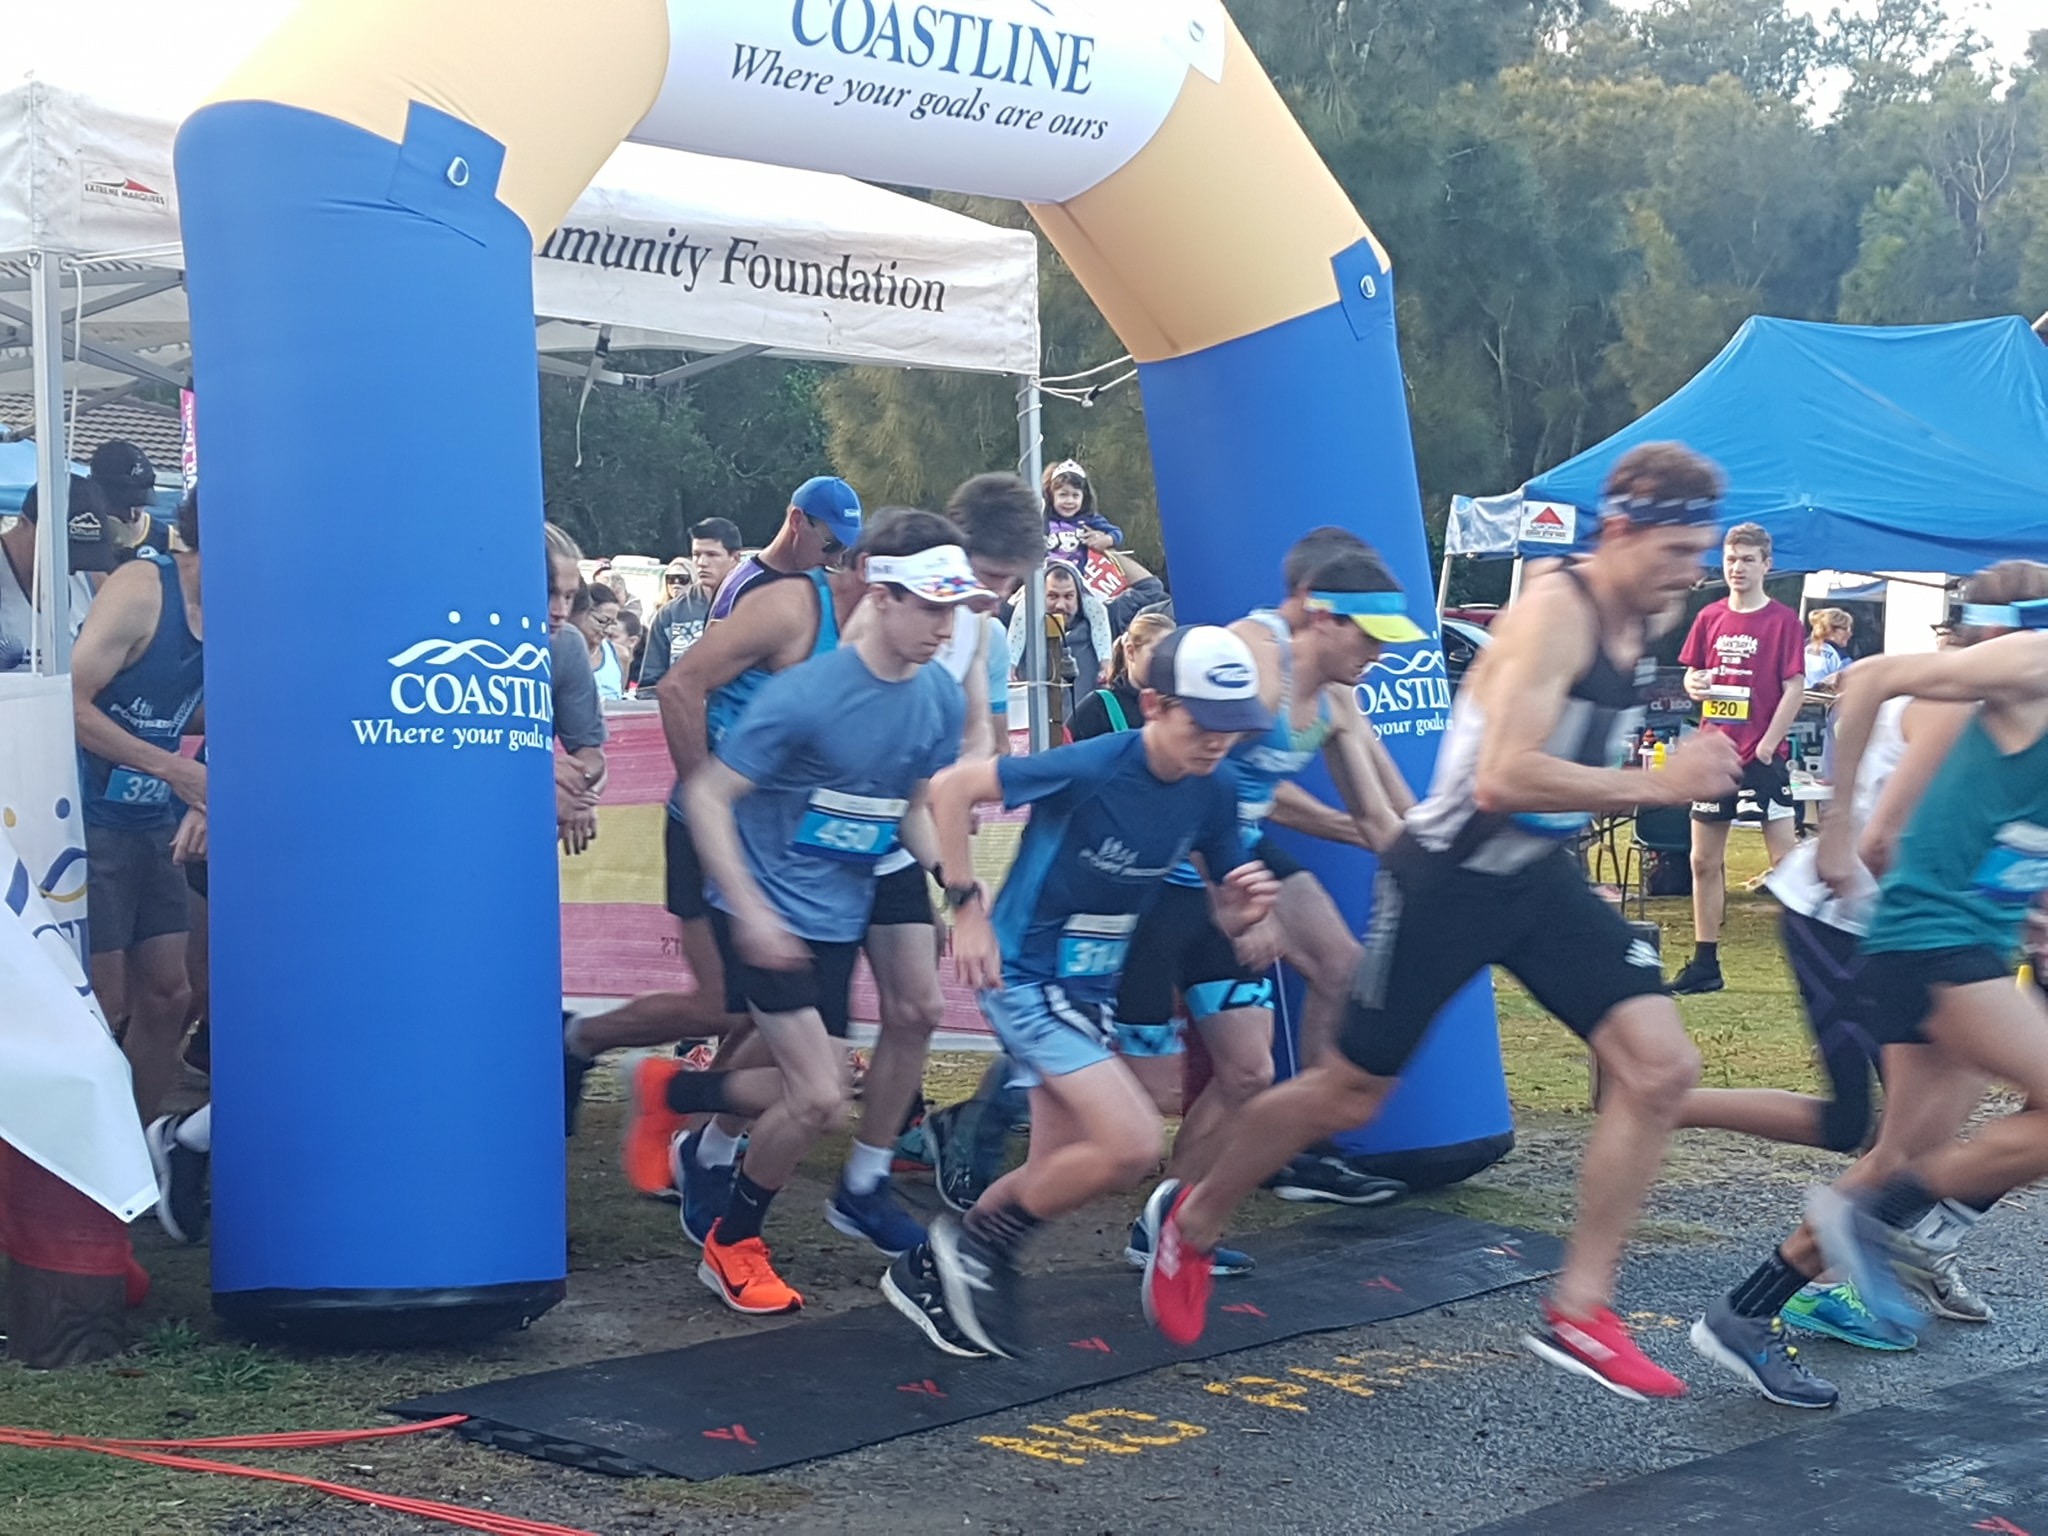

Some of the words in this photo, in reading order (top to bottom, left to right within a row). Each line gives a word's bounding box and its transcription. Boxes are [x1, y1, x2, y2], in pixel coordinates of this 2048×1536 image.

[791, 0, 1096, 96] COASTLINE
[730, 42, 834, 96] Where
[833, 78, 912, 107] your
[909, 87, 990, 121] goals
[994, 105, 1044, 131] are
[1048, 112, 1109, 141] ours
[719, 236, 946, 313] Foundation
[1709, 700, 1738, 717] 520
[351, 718, 445, 744] Where
[452, 727, 504, 750] your
[508, 723, 544, 751] goals
[1372, 719, 1412, 741] your
[1415, 711, 1445, 736] goals
[122, 776, 167, 802] 324
